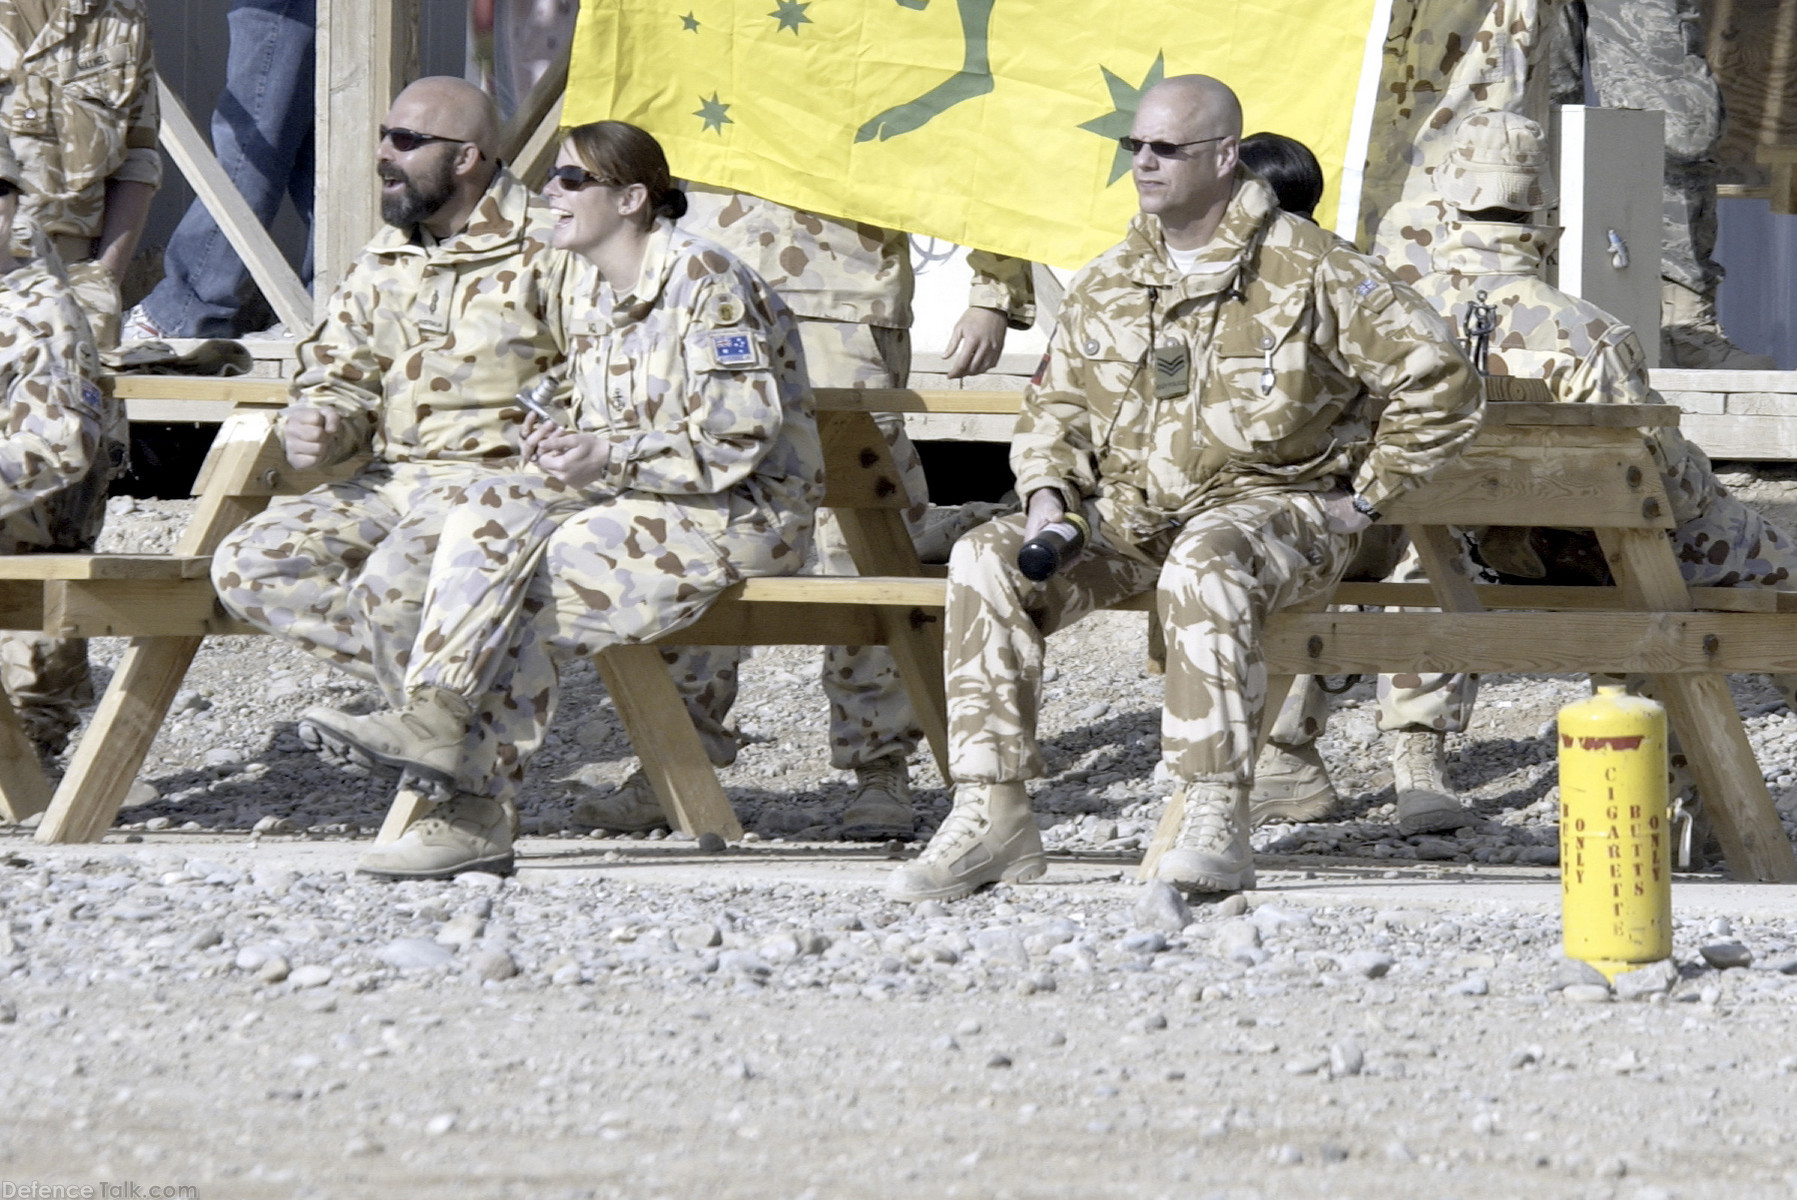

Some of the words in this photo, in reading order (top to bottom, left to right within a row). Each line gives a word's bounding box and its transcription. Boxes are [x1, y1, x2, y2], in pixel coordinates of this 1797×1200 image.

[1575, 817, 1586, 885] ONLY
[1604, 766, 1624, 938] CIGARETTE
[1629, 803, 1645, 897] BUTTS
[1649, 813, 1661, 883] ONLY
